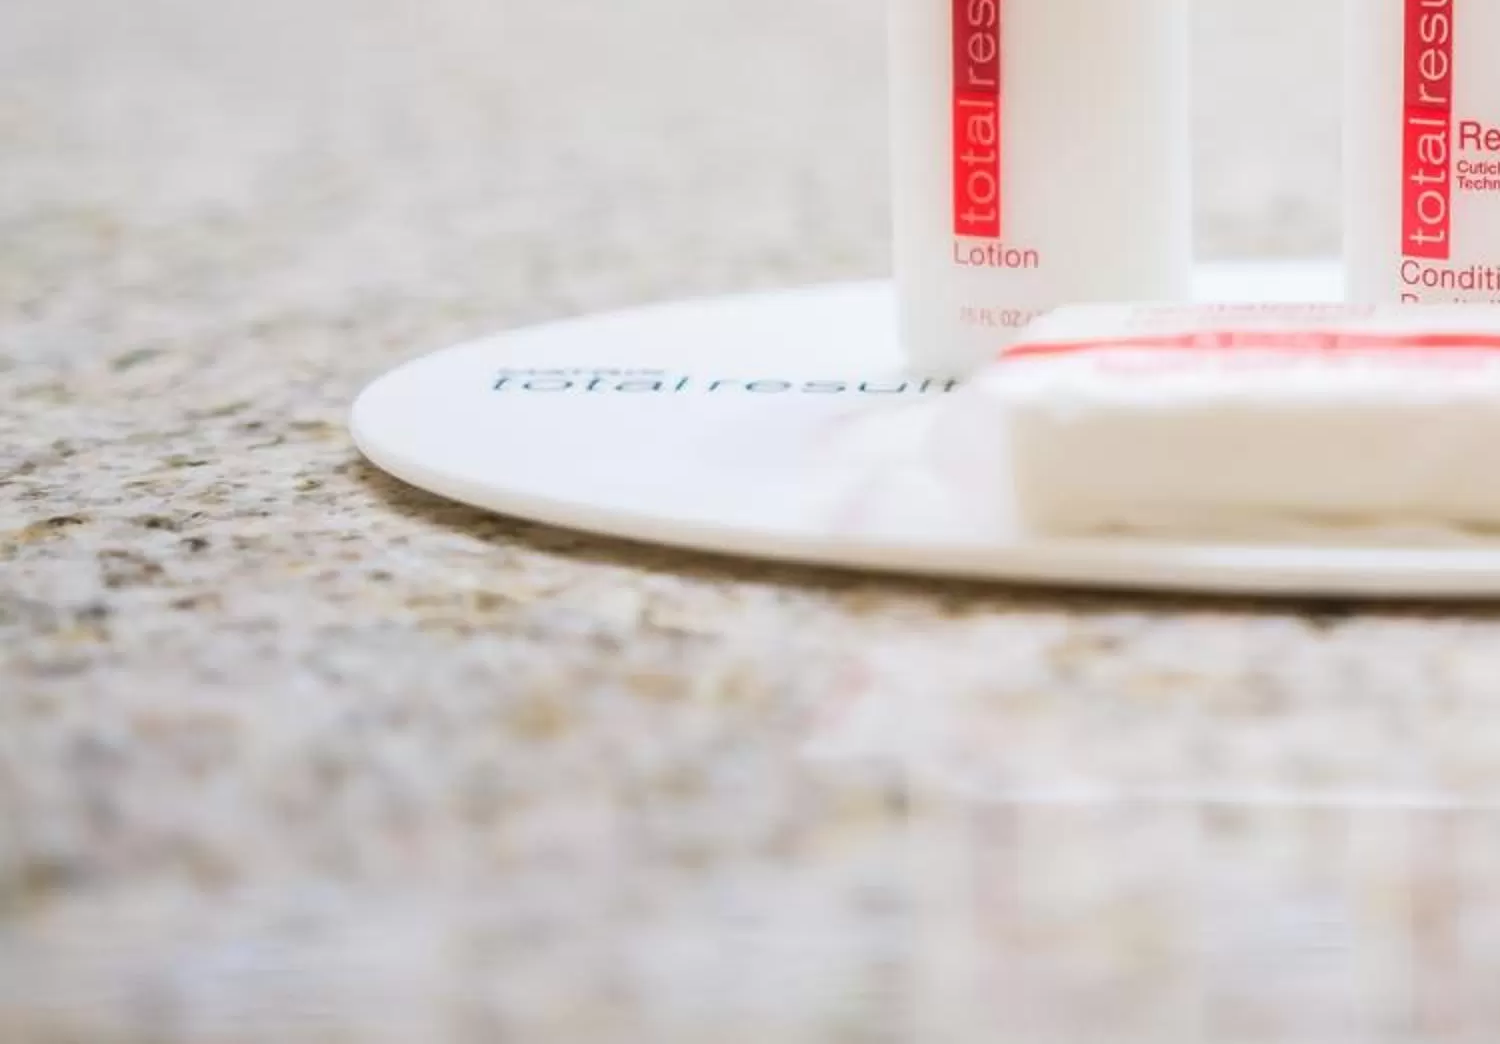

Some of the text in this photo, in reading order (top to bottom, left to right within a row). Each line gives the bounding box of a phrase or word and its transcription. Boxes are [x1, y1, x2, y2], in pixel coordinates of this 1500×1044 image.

[958, 97, 997, 226] total
[1409, 116, 1447, 246] total
[953, 239, 1039, 269] Lotion
